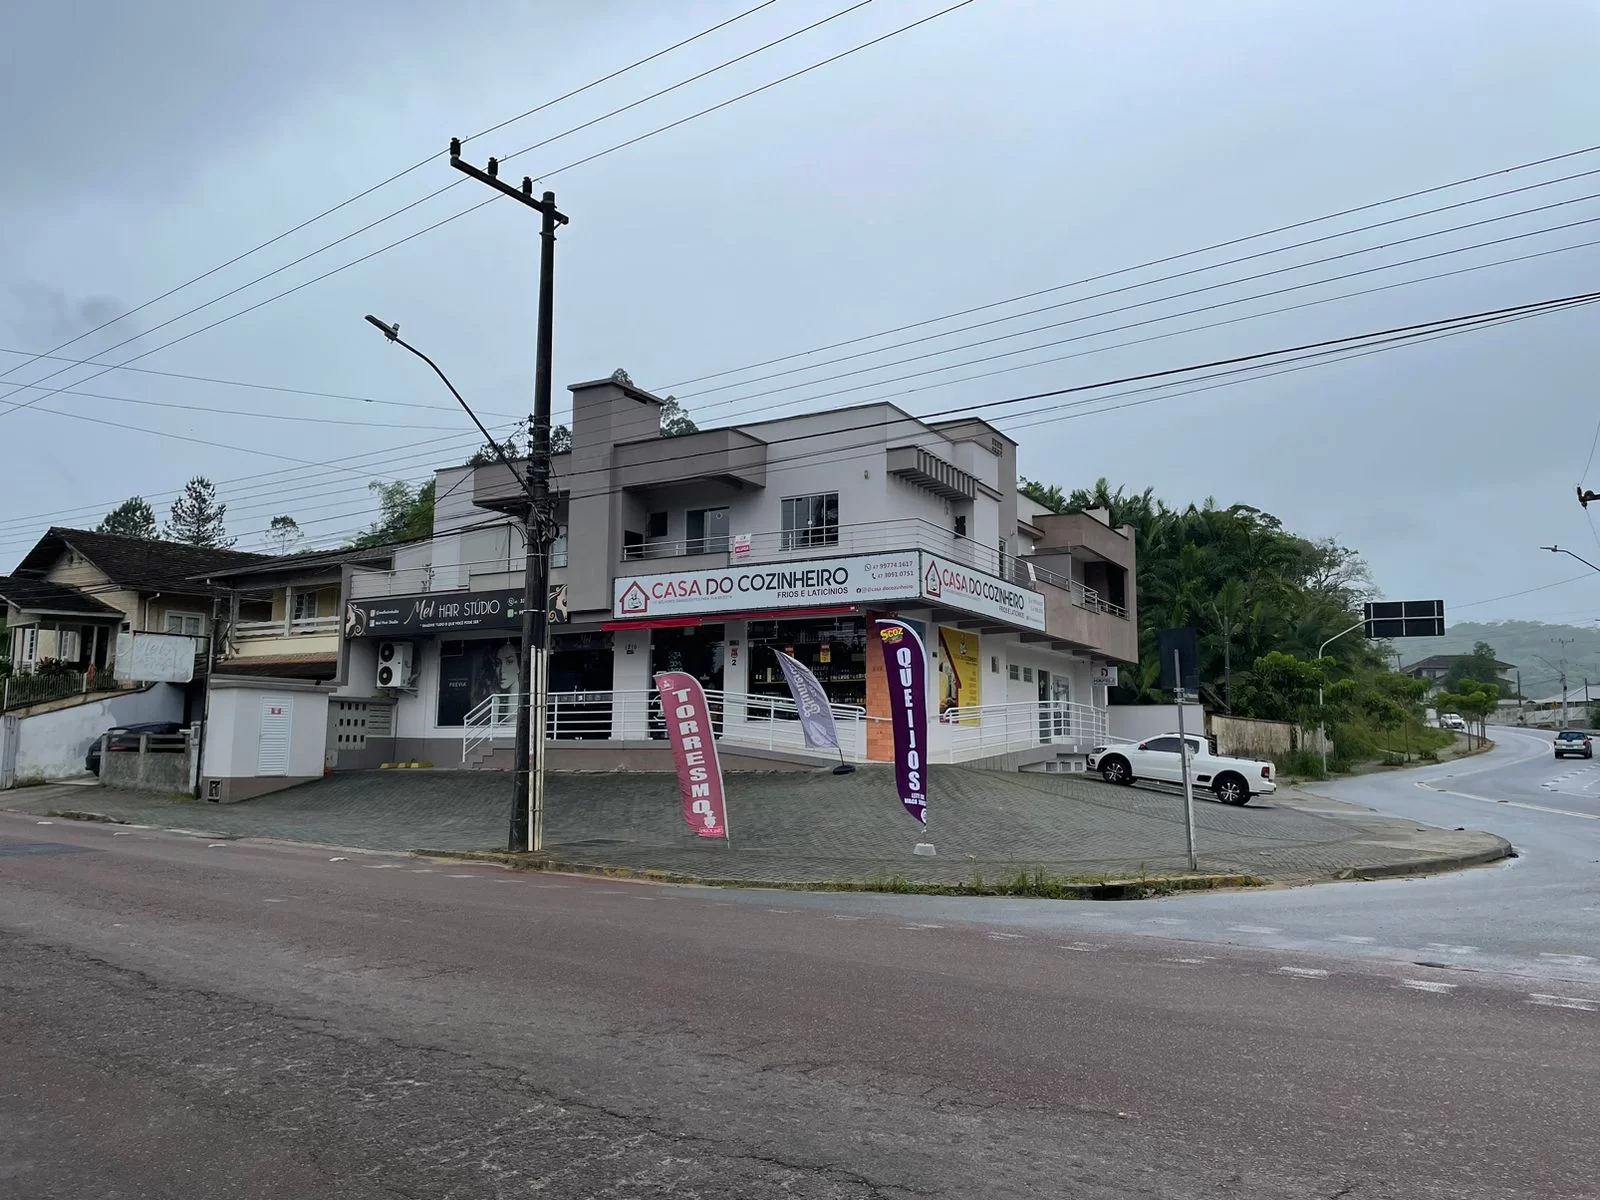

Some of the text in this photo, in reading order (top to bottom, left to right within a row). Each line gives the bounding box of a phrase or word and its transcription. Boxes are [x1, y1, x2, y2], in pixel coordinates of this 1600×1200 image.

[652, 567, 849, 599] CASA DO COZINHEIRO
[807, 587, 849, 597] LATICÍNIOS
[942, 569, 968, 593] CASA
[969, 577, 982, 596] DO
[982, 582, 1025, 610] COZINHEIRO
[403, 598, 501, 625] Mel HAIR STÚDIO
[896, 647, 920, 791] QUEIJOS
[672, 688, 711, 814] TORRESMO
